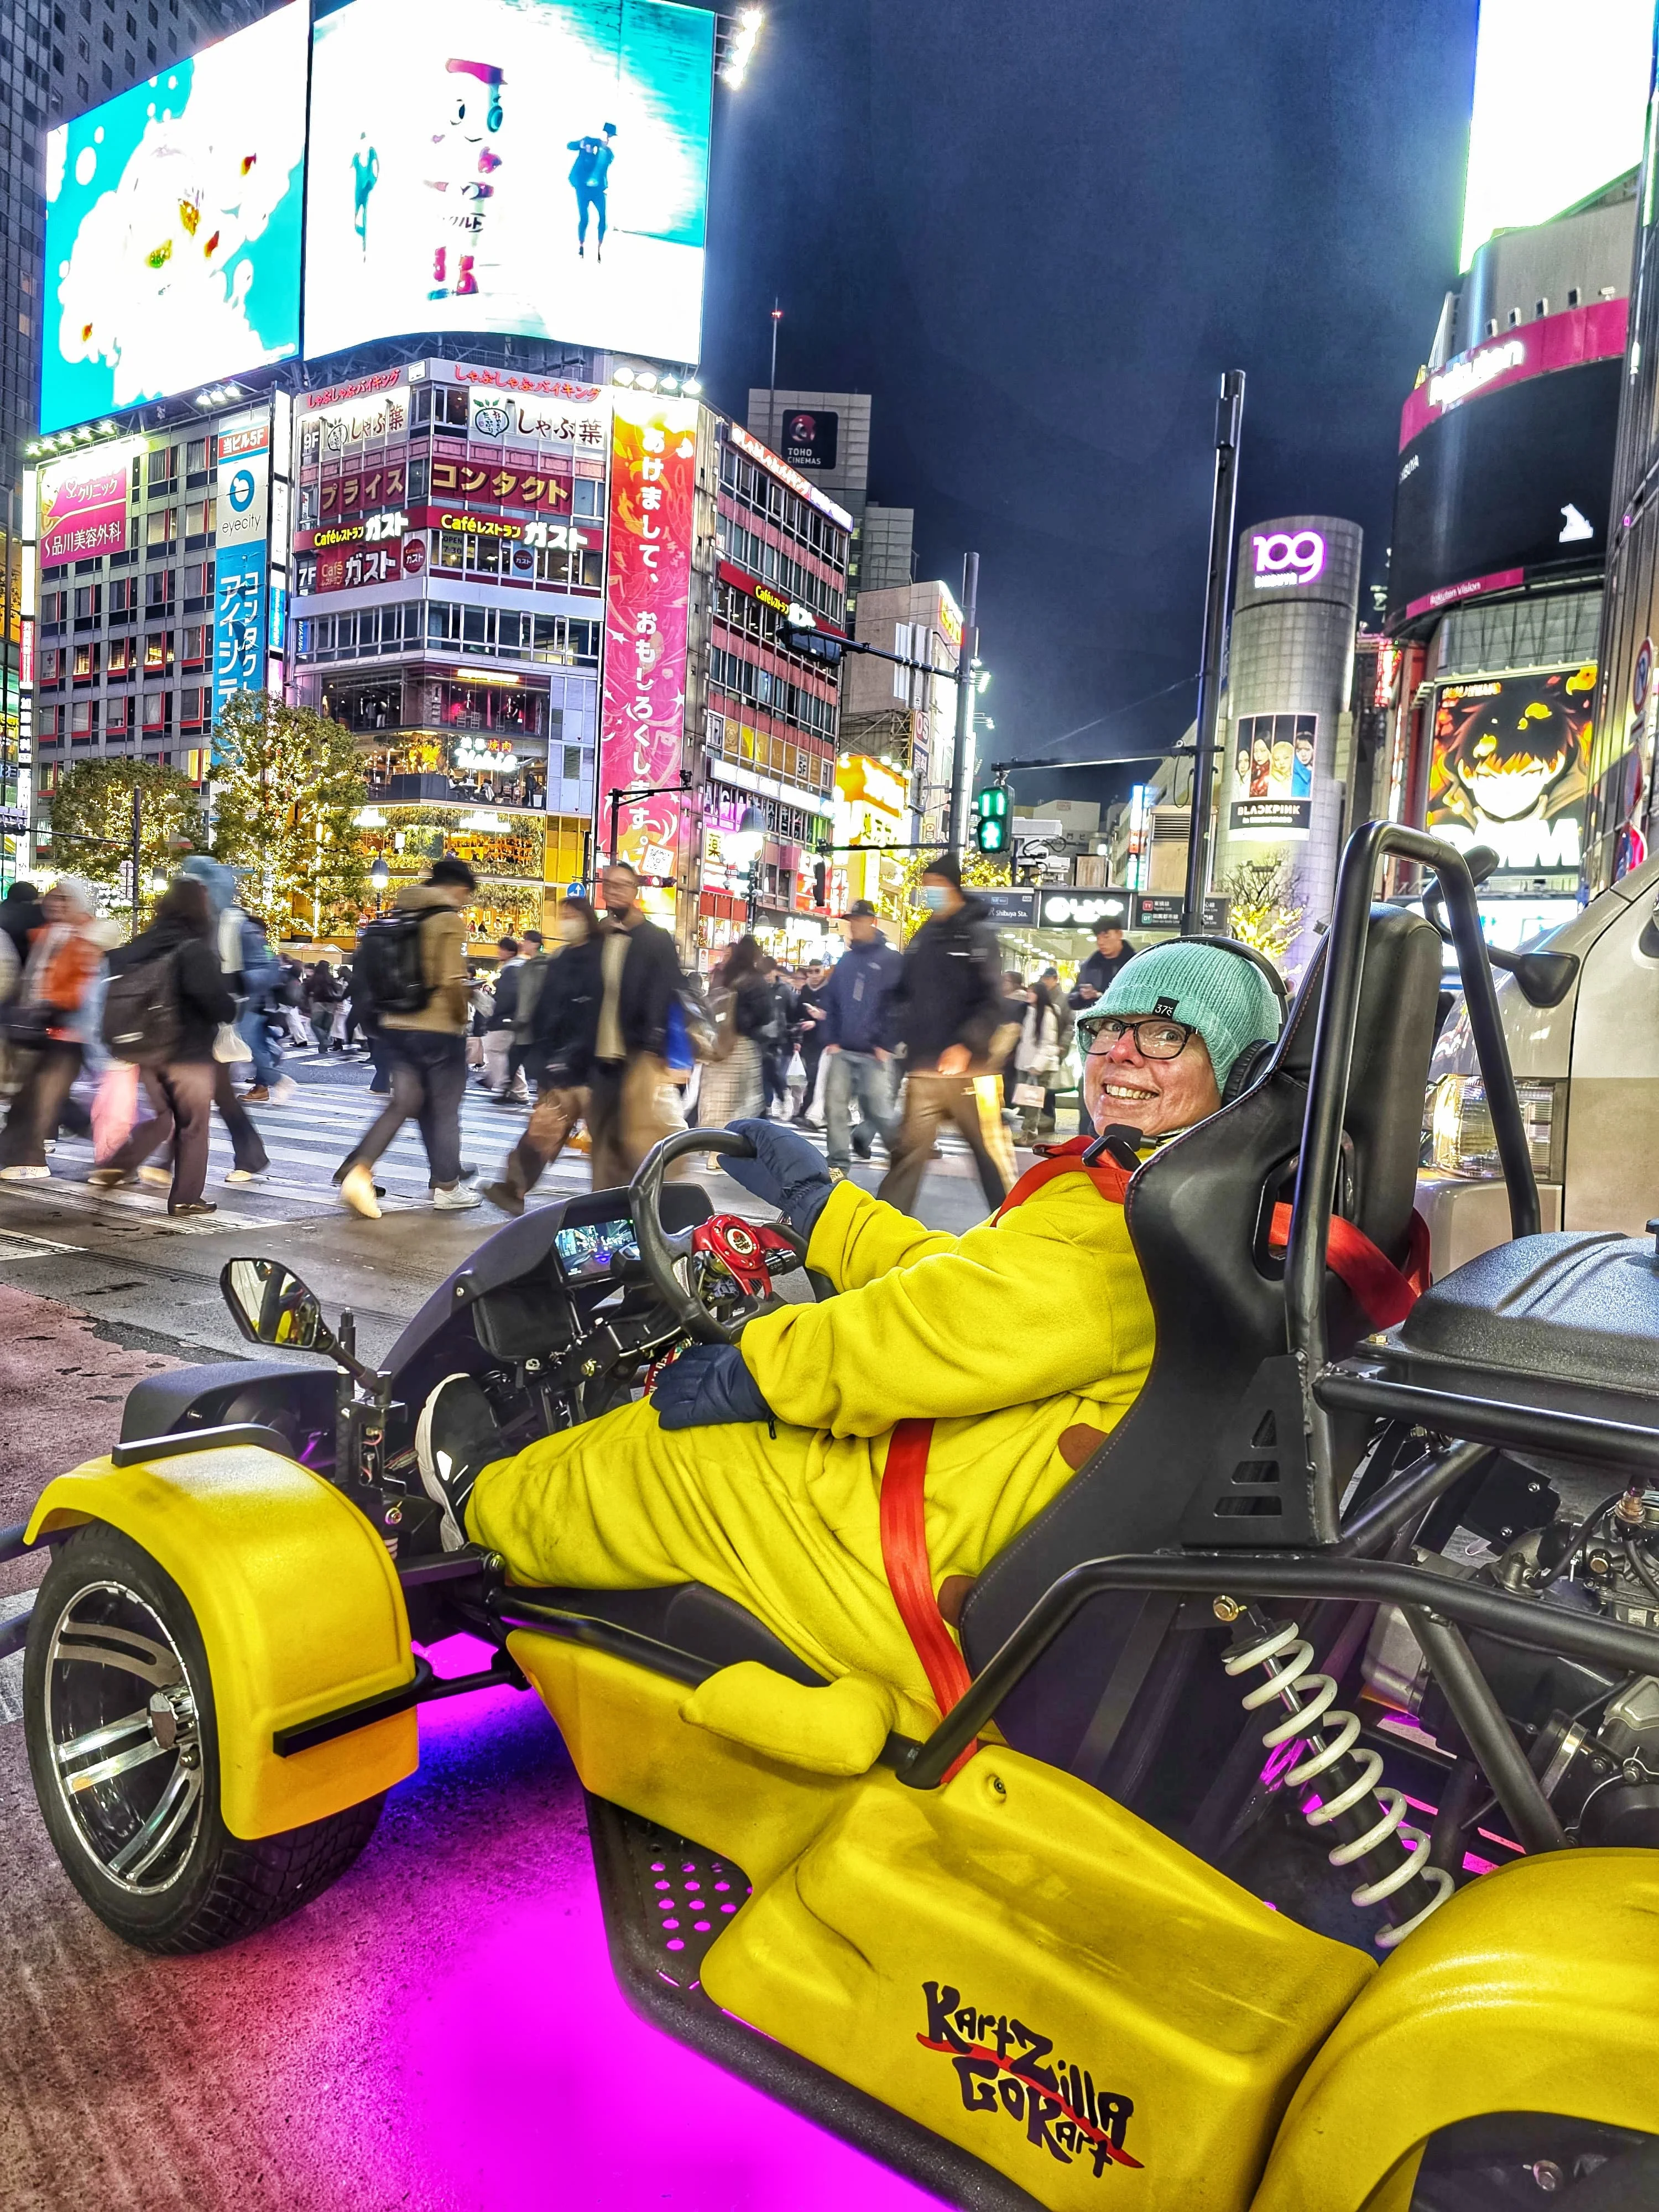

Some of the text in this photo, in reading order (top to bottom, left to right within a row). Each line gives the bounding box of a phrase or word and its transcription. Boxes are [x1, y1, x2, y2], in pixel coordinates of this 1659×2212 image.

[307, 369, 400, 408] しゃぶしゃぶバイキング
[455, 364, 601, 402] しゃぶしゃぶバイキング
[351, 404, 404, 440] しゃぶ葉
[518, 408, 602, 445] しゃぶ葉
[222, 427, 264, 455] 当ビル5F
[304, 431, 319, 450] 9F
[787, 447, 812, 457] TOHO
[787, 456, 821, 465] CINEMAS
[77, 478, 118, 503] クリニック
[322, 469, 404, 510] プライス
[433, 463, 568, 505] コンタクト
[52, 520, 121, 556] 品川美容外科
[222, 513, 262, 536] eyecity
[365, 511, 409, 541] ガスト
[524, 521, 588, 551] ガスト
[321, 550, 397, 587] Café ガスト
[406, 553, 424, 564] ガスト
[1253, 531, 1324, 584] 109
[299, 566, 317, 587] 7F
[1430, 582, 1481, 605] Rakuten Vision
[1237, 805, 1301, 816] BLACKPINK
[996, 910, 1016, 918] Shibuya
